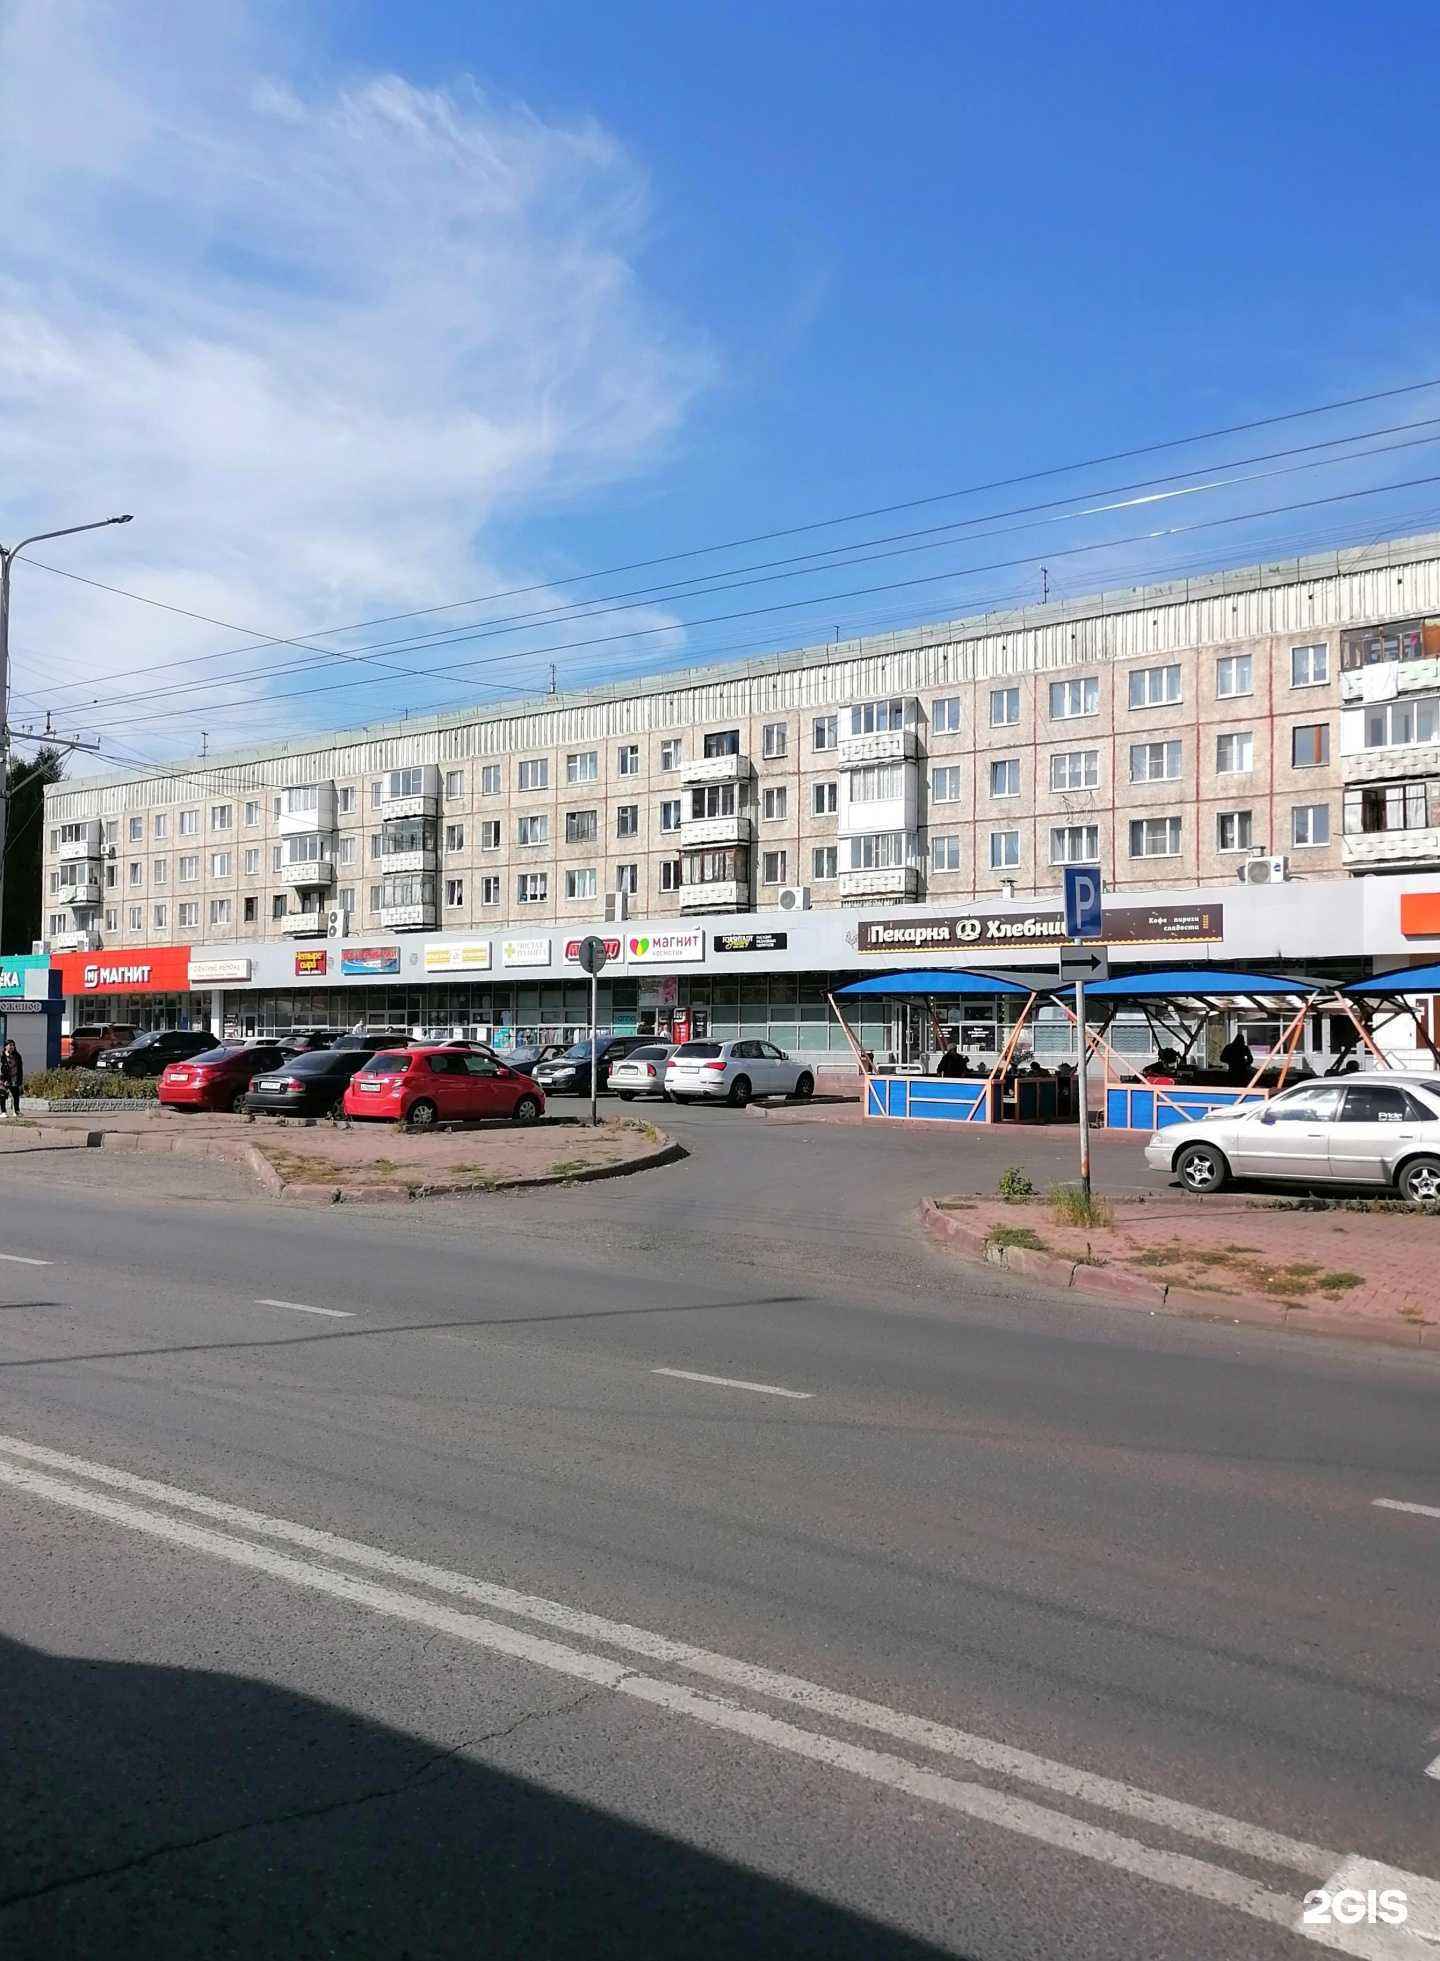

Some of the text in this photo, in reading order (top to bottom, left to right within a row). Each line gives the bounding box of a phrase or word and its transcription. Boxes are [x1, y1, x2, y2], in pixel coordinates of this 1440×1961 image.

[1074, 876, 1095, 929] P
[870, 925, 950, 945] Пекарня
[99, 965, 151, 984] МАГНИТ
